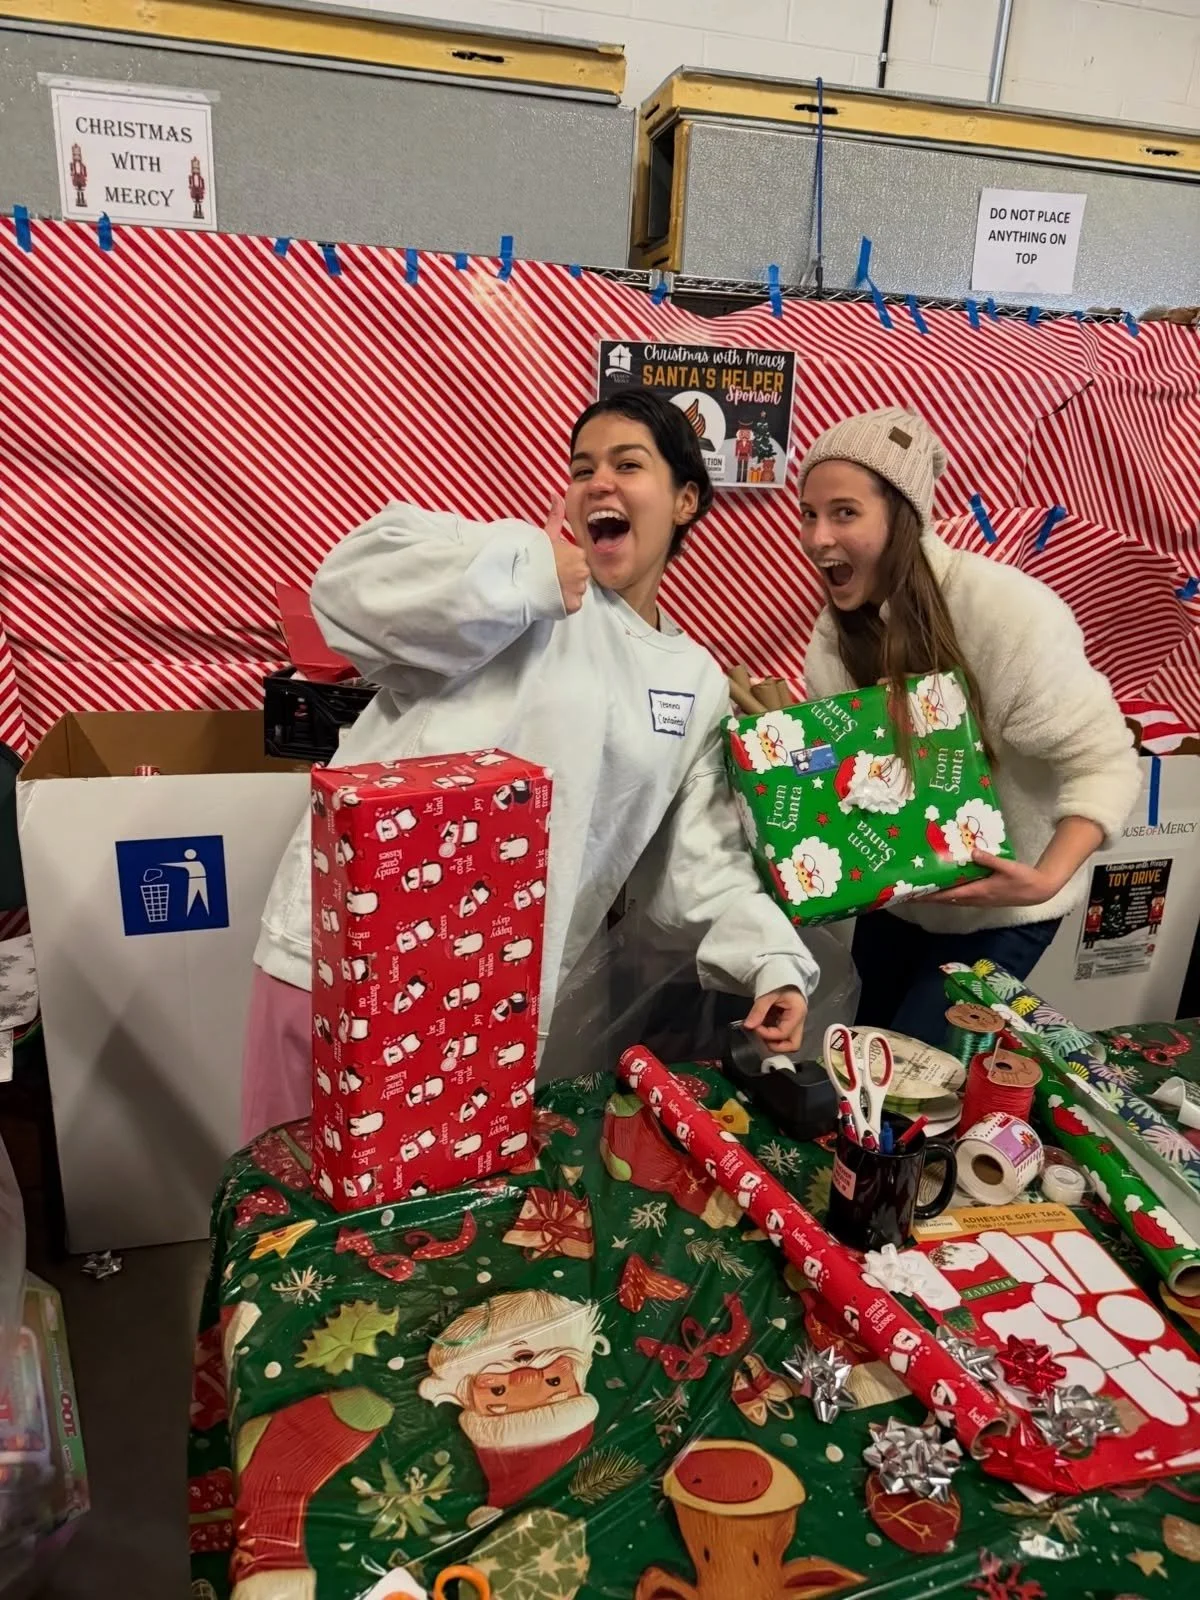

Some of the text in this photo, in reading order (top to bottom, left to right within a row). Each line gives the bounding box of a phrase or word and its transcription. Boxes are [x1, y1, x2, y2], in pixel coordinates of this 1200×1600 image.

[75, 116, 193, 143] CHRISTMAS
[111, 151, 161, 173] WITH
[105, 186, 174, 207] MERCY
[990, 207, 1071, 224] DO NOT PLACE
[988, 230, 1066, 245] ANYTHING ON
[1015, 252, 1037, 264] TOP
[643, 344, 786, 371] Christmas with Mercy
[642, 364, 784, 393] SANTA'S HELPER
[726, 384, 783, 406] Sponsor
[811, 704, 847, 742] From
[929, 747, 949, 791] From
[945, 748, 965, 794] Santa
[423, 802, 433, 813] be
[433, 796, 444, 816] kind
[472, 797, 484, 812] joy
[766, 784, 787, 828] From
[782, 786, 802, 832] Santa
[857, 819, 896, 862] Santa
[1122, 826, 1145, 838] USE
[1158, 822, 1198, 835] MERCY
[847, 831, 883, 873] From
[374, 866, 400, 880] candy
[453, 857, 463, 875] cool
[1108, 869, 1162, 887] TOY DRIVE
[437, 914, 448, 940] cheers
[490, 925, 513, 938] happy
[390, 955, 400, 984] believe
[359, 997, 367, 1008] no
[370, 983, 381, 1015] peeking
[435, 1017, 446, 1037] kind
[471, 1014, 484, 1027] joy
[454, 1069, 464, 1085] cool
[351, 1147, 376, 1159] merry
[962, 1210, 1066, 1224] ADHESIVE GIFT TAGS
[791, 1227, 812, 1252] believe
[964, 1278, 1013, 1299] BELIEVE
[865, 1298, 888, 1318] candy
[871, 1306, 889, 1324] cane
[872, 1312, 897, 1334] kisses
[967, 1406, 988, 1428] beli
